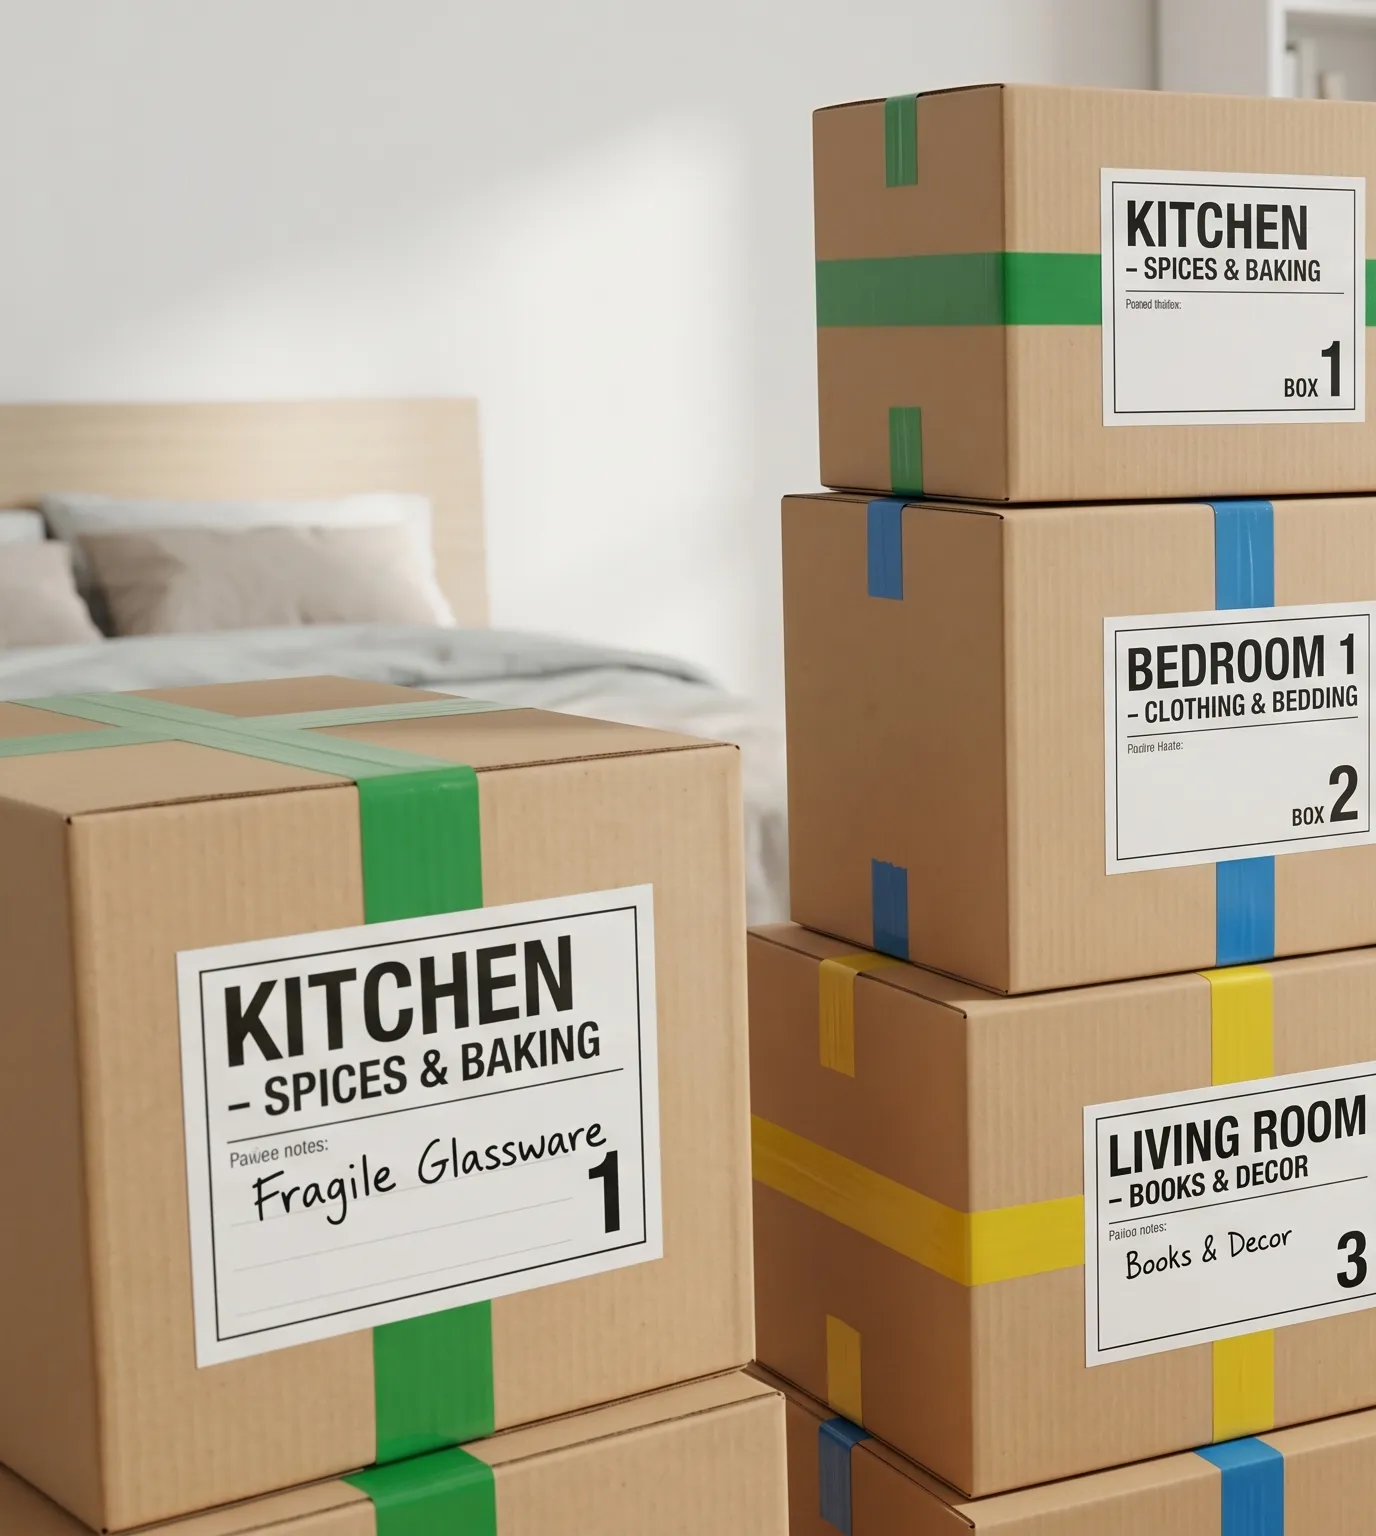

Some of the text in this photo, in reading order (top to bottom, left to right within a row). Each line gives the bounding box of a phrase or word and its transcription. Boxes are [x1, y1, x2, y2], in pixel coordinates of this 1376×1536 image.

[1127, 200, 1307, 250] KITCHEN
[1144, 256, 1218, 281] SPICES
[1223, 259, 1239, 281] &
[1246, 259, 1321, 282] BAKING
[1284, 340, 1341, 397] BOX 1
[1128, 633, 1354, 691] BEDROOM 1
[1145, 693, 1245, 723] CLOTHING
[1251, 692, 1266, 715] &
[1272, 684, 1358, 713] BEDDING
[1292, 764, 1358, 827] BOX 2
[224, 934, 574, 1068] KITCHEN
[264, 1055, 407, 1116] SPICES
[420, 1049, 449, 1088] &
[461, 1020, 601, 1081] BAKING
[283, 1138, 330, 1158] notes:
[1109, 1094, 1366, 1178] LIVING ROOM
[252, 1122, 608, 1225] Fragile Glassware
[588, 1149, 622, 1234] 1
[1130, 1172, 1205, 1208] BOOKS
[1212, 1169, 1229, 1193] &
[1236, 1155, 1308, 1189] DECOR
[1126, 1229, 1293, 1280] Books & Decor
[1139, 1222, 1167, 1236] notes:
[1336, 1230, 1367, 1288] 3
